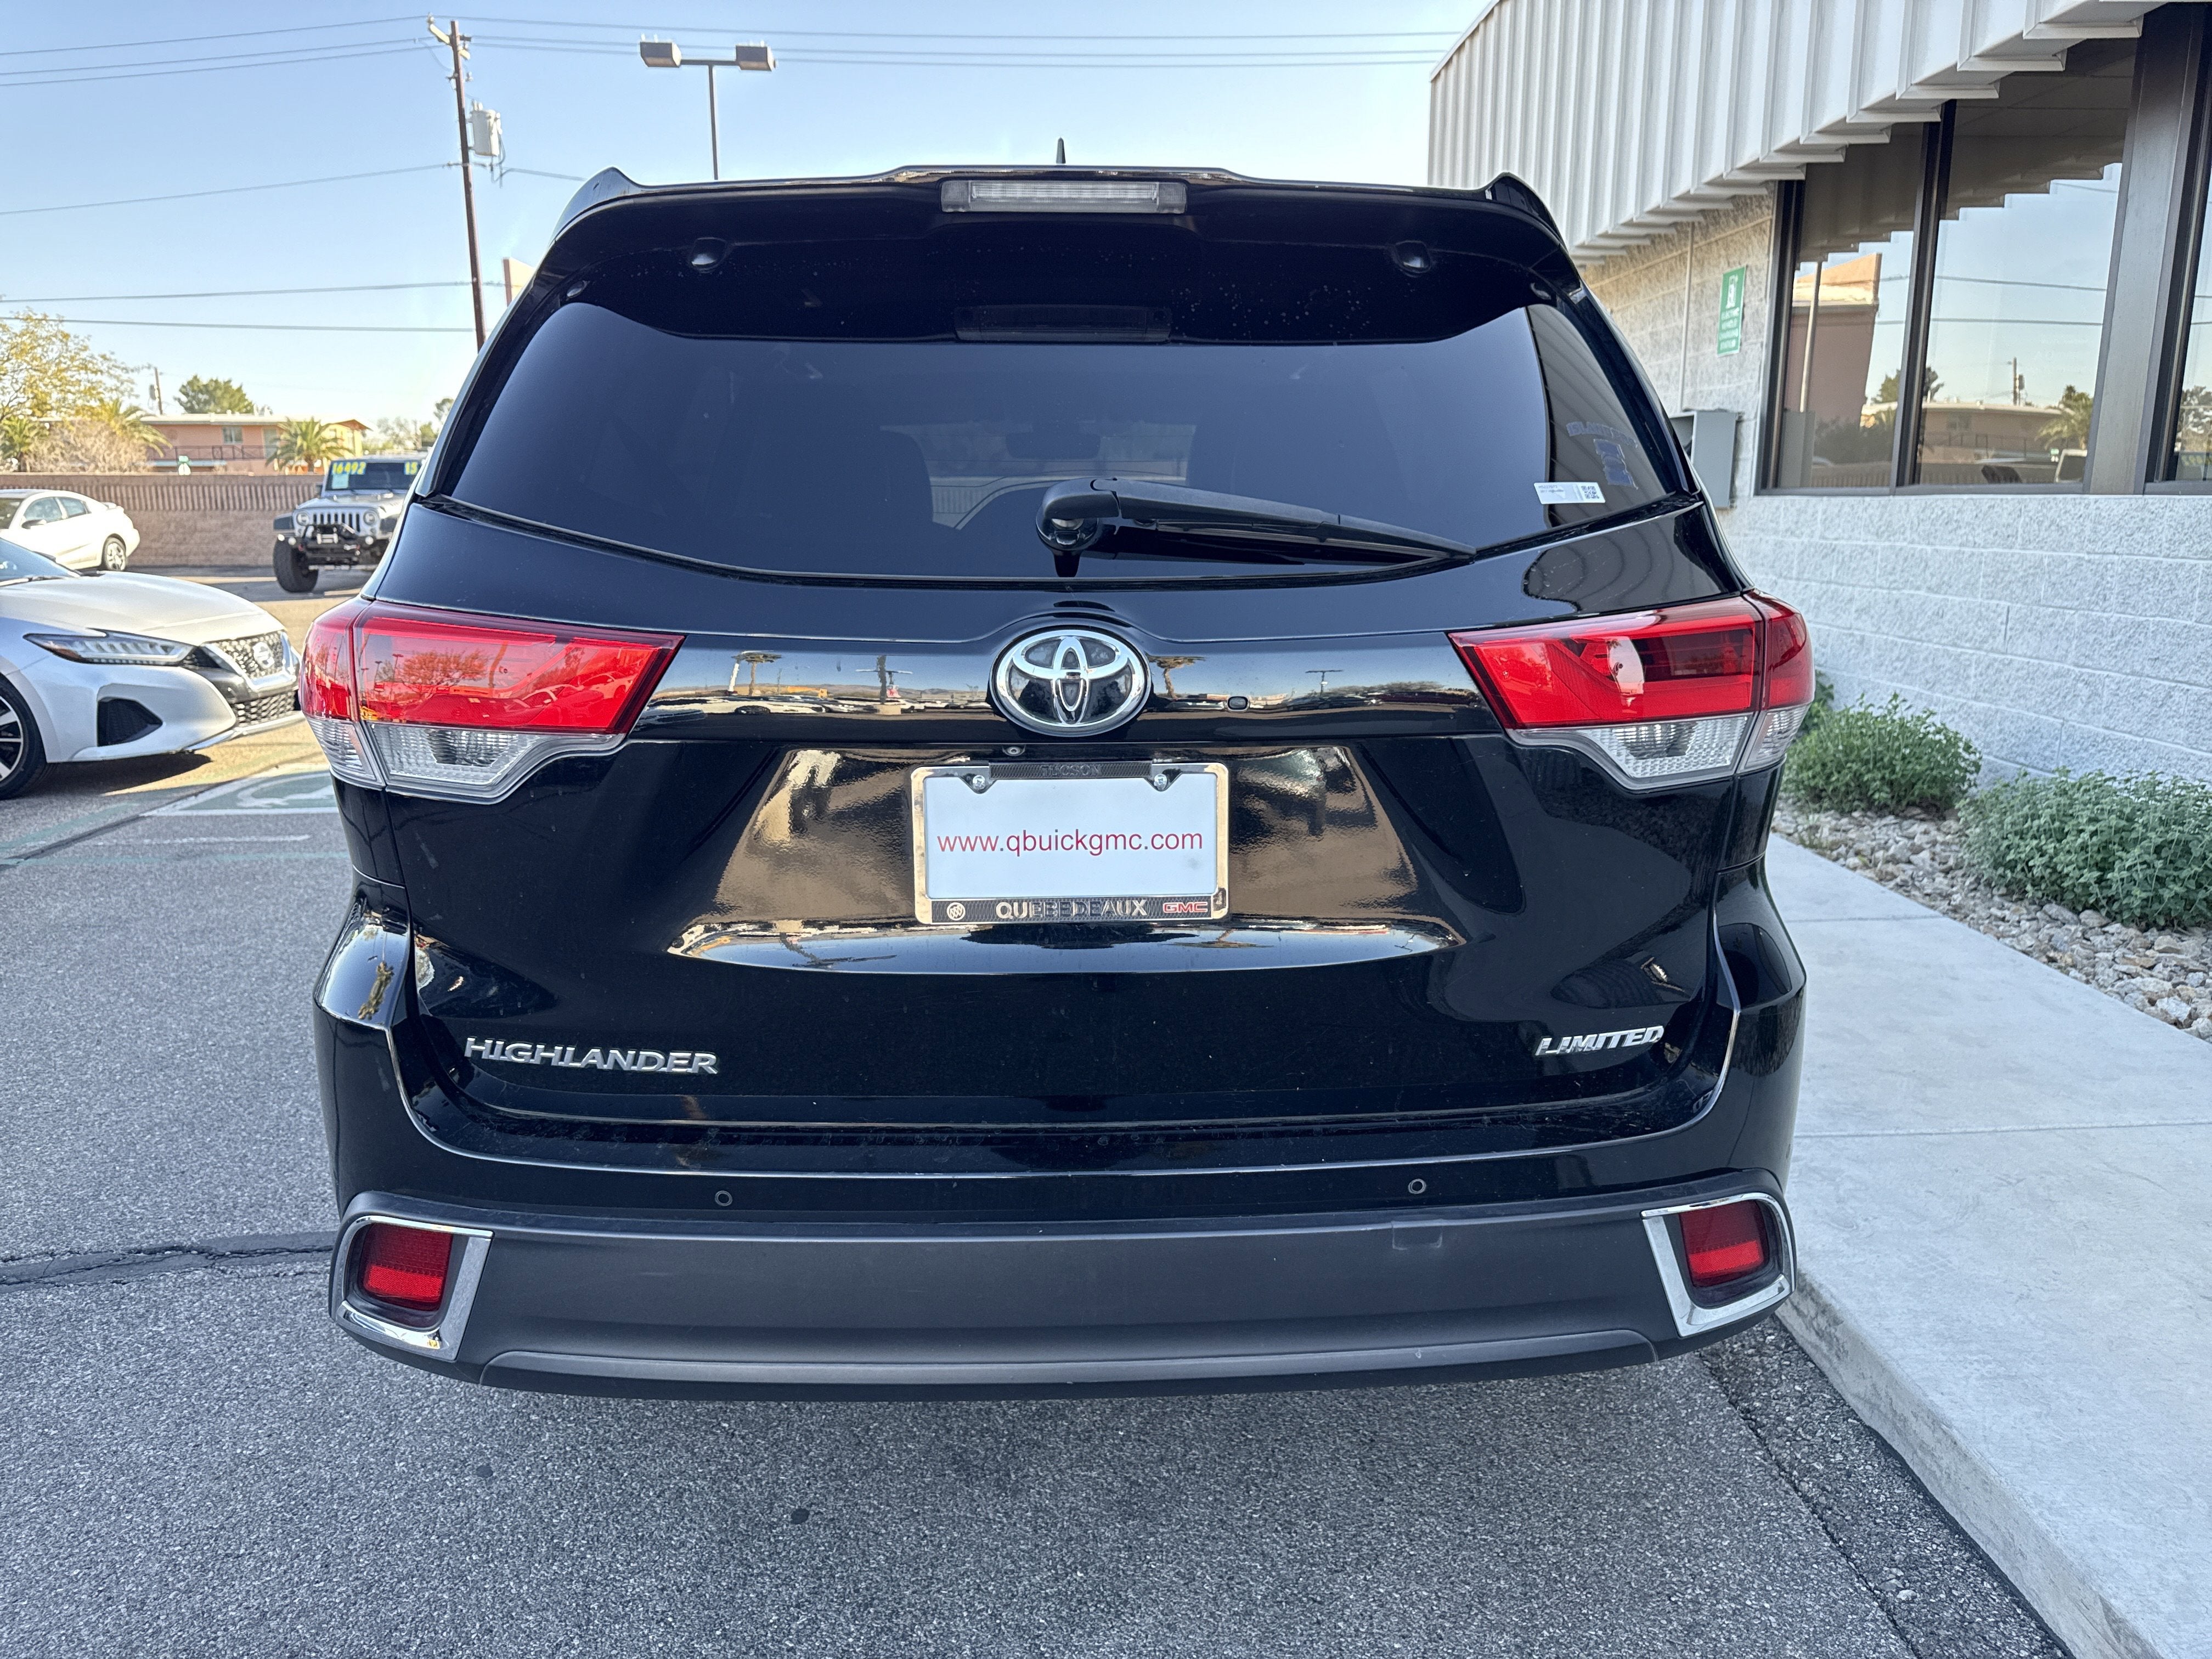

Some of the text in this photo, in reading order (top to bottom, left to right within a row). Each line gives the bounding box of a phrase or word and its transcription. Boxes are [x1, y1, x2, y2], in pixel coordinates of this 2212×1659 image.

[405, 461, 418, 475] 15
[937, 828, 1203, 856] www.qbuickgmc.com
[995, 899, 1148, 919] QUEBEDEAUX
[1163, 901, 1208, 913] GMC
[1536, 1025, 1664, 1056] LIMITED
[464, 1037, 719, 1074] HIGHLANDER
